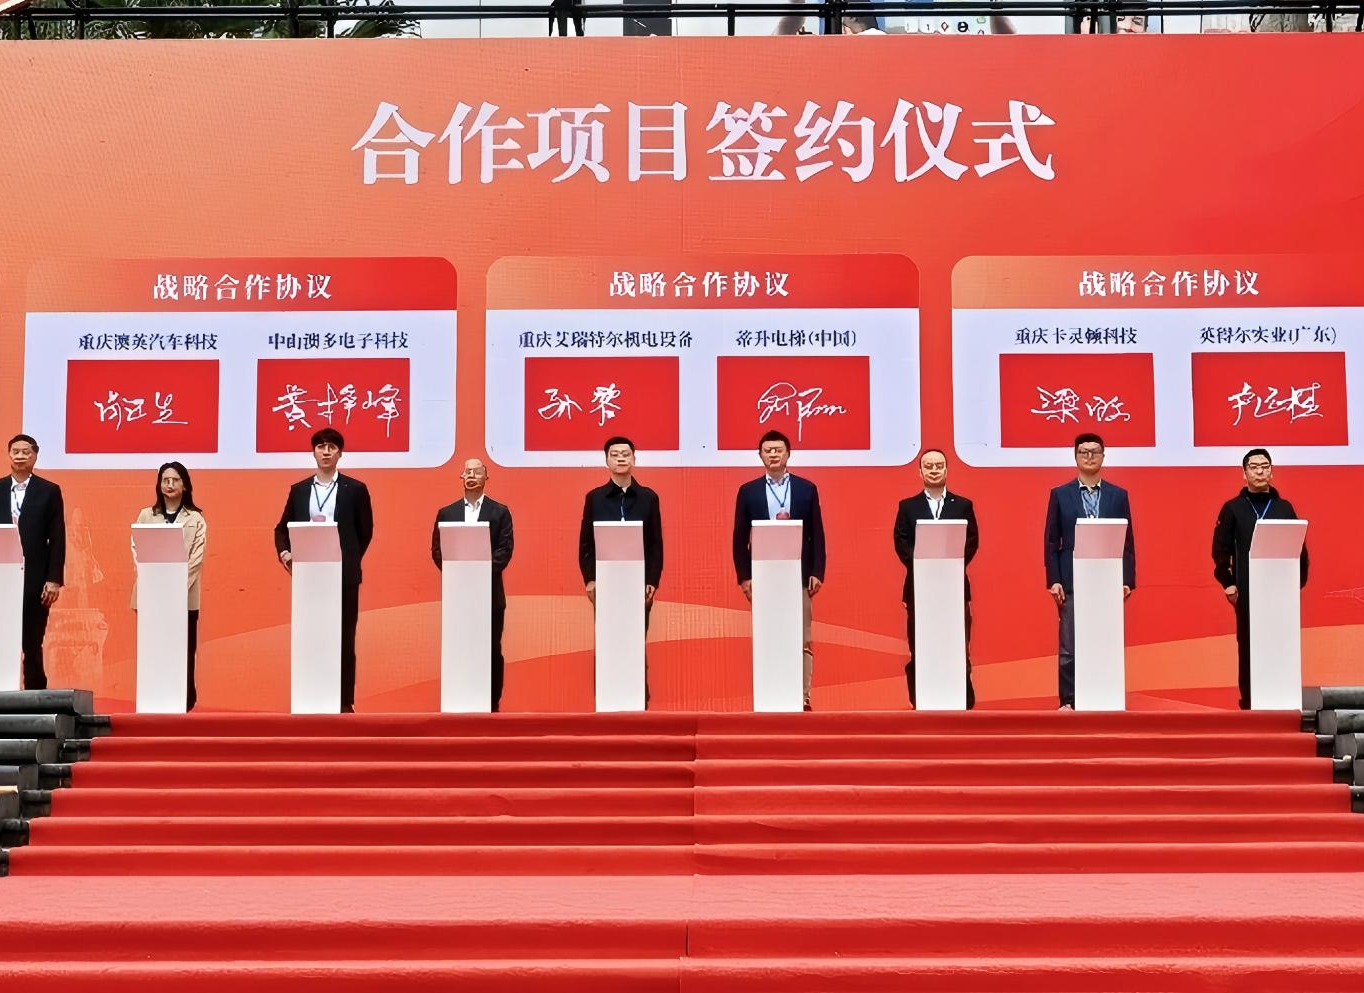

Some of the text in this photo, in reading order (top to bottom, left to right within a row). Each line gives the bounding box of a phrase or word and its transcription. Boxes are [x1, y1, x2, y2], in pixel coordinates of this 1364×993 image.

[351, 98, 1056, 185] 合作项目签约仪式
[154, 274, 332, 300] 战略合作协议
[609, 271, 789, 297] 战略合作协议
[1078, 270, 1259, 297] 战略合作协议
